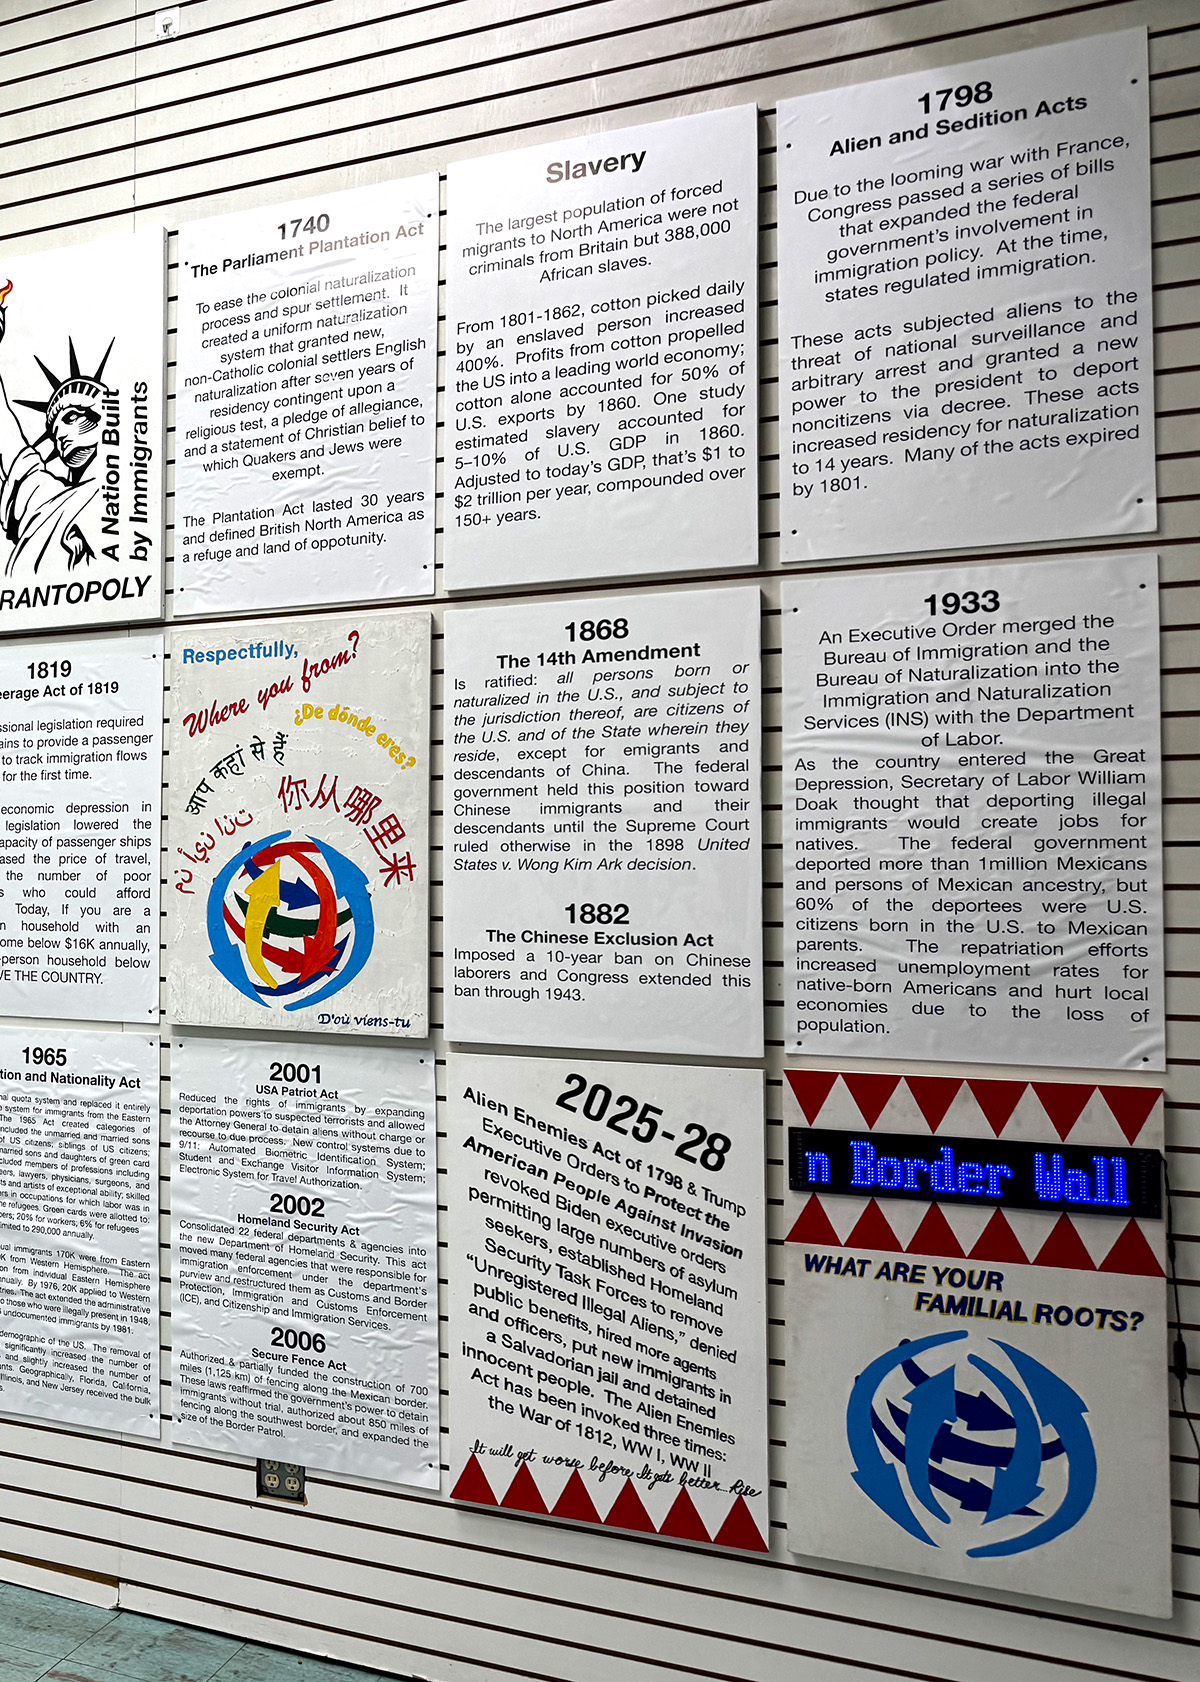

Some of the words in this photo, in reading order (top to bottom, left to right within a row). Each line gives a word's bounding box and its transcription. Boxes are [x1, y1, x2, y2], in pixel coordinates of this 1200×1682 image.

[918, 81, 993, 115] 1798
[829, 136, 881, 157] Alien
[888, 122, 929, 145] and
[936, 108, 1027, 135] Sedition
[1034, 96, 1088, 118] Acts
[546, 150, 647, 183] Slavery
[277, 213, 329, 240] 1740
[190, 264, 218, 278] The
[222, 245, 304, 272] Parliament
[309, 231, 389, 255] Plantation
[396, 223, 424, 239] Act
[539, 265, 593, 283] African
[598, 256, 651, 273] slaves.
[101, 389, 120, 446] Built
[129, 381, 153, 523] Immigrants
[101, 454, 120, 535] Nation
[793, 482, 814, 499] by
[820, 475, 867, 493] 1801.
[455, 513, 491, 527] 150+
[496, 510, 541, 527] years.
[101, 544, 120, 562] A
[129, 531, 153, 561] by
[924, 589, 1000, 616] 1933
[565, 617, 629, 642] 1868
[183, 640, 299, 665] Respectfully,
[496, 654, 531, 669] The
[537, 650, 576, 667] 14th
[581, 642, 701, 664] Amendment
[27, 660, 72, 679] 1819
[43, 685, 66, 697] Act
[69, 683, 84, 696] of
[87, 681, 119, 695] 1819
[182, 699, 250, 738] Where
[257, 675, 294, 711] you
[301, 630, 360, 693] from?
[294, 703, 323, 726] ¿De
[328, 703, 377, 737] dónde
[376, 733, 417, 770] eres?
[920, 732, 940, 747] of
[945, 731, 1003, 747] Labor.
[277, 773, 417, 888] 你从哪里来
[564, 903, 630, 925] 1882
[485, 929, 516, 943] The
[521, 930, 589, 945] Chinese
[594, 931, 678, 946] Exclusion
[683, 933, 714, 947] Act
[14, 970, 38, 982] THE
[41, 970, 103, 984] COUNTRY.
[318, 1013, 351, 1025] D'où
[353, 1014, 411, 1028] viens-tu
[797, 1018, 890, 1034] population.
[21, 1046, 67, 1067] 1965
[24, 1071, 47, 1082] and
[50, 1071, 116, 1090] Nationality
[119, 1076, 141, 1089] Act
[269, 1062, 322, 1084] 2001
[256, 1084, 279, 1095] USA
[281, 1086, 317, 1098] Patriot
[318, 1089, 339, 1100] Act
[555, 1073, 732, 1172] 2025-28
[463, 1086, 508, 1117] Alien
[514, 1106, 588, 1150] Enemies
[592, 1141, 621, 1165] Act
[625, 1158, 643, 1173] of
[646, 1164, 683, 1190] 1798
[687, 1181, 697, 1197] &
[701, 1186, 746, 1218] Trump
[179, 1164, 220, 1176] Electronic
[222, 1168, 254, 1180] System
[257, 1171, 269, 1181] for
[271, 1172, 297, 1184] Travel
[299, 1175, 363, 1190] Authorization.
[805, 1151, 831, 1184] n
[850, 1140, 1014, 1197] Border
[1033, 1151, 1130, 1206] Wall
[269, 1193, 325, 1218] 2002
[237, 1213, 291, 1228] Homeland
[293, 1219, 338, 1236] Security
[340, 1225, 360, 1236] Act
[804, 1253, 871, 1276] WHAT
[875, 1261, 926, 1285] ARE
[932, 1266, 1004, 1292] YOUR
[3, 1310, 57, 1323] undocumented
[59, 1316, 99, 1330] immigrants
[101, 1323, 111, 1333] by
[113, 1324, 134, 1334] 1981.
[913, 1292, 1028, 1324] FAMILIAL
[1032, 1303, 1144, 1333] ROOTS?
[270, 1326, 326, 1353] 2006
[251, 1347, 289, 1363] Secure
[291, 1353, 325, 1368] Fence
[327, 1359, 347, 1372] Act
[180, 1413, 197, 1422] size
[199, 1415, 208, 1424] of
[209, 1417, 224, 1427] the
[225, 1419, 255, 1432] Border
[257, 1424, 286, 1438] Patrol.
[469, 1439, 486, 1455] It
[489, 1443, 514, 1458] will
[517, 1449, 537, 1467] get
[542, 1454, 585, 1469] worse
[588, 1456, 634, 1482] before
[650, 1473, 674, 1488] gets
